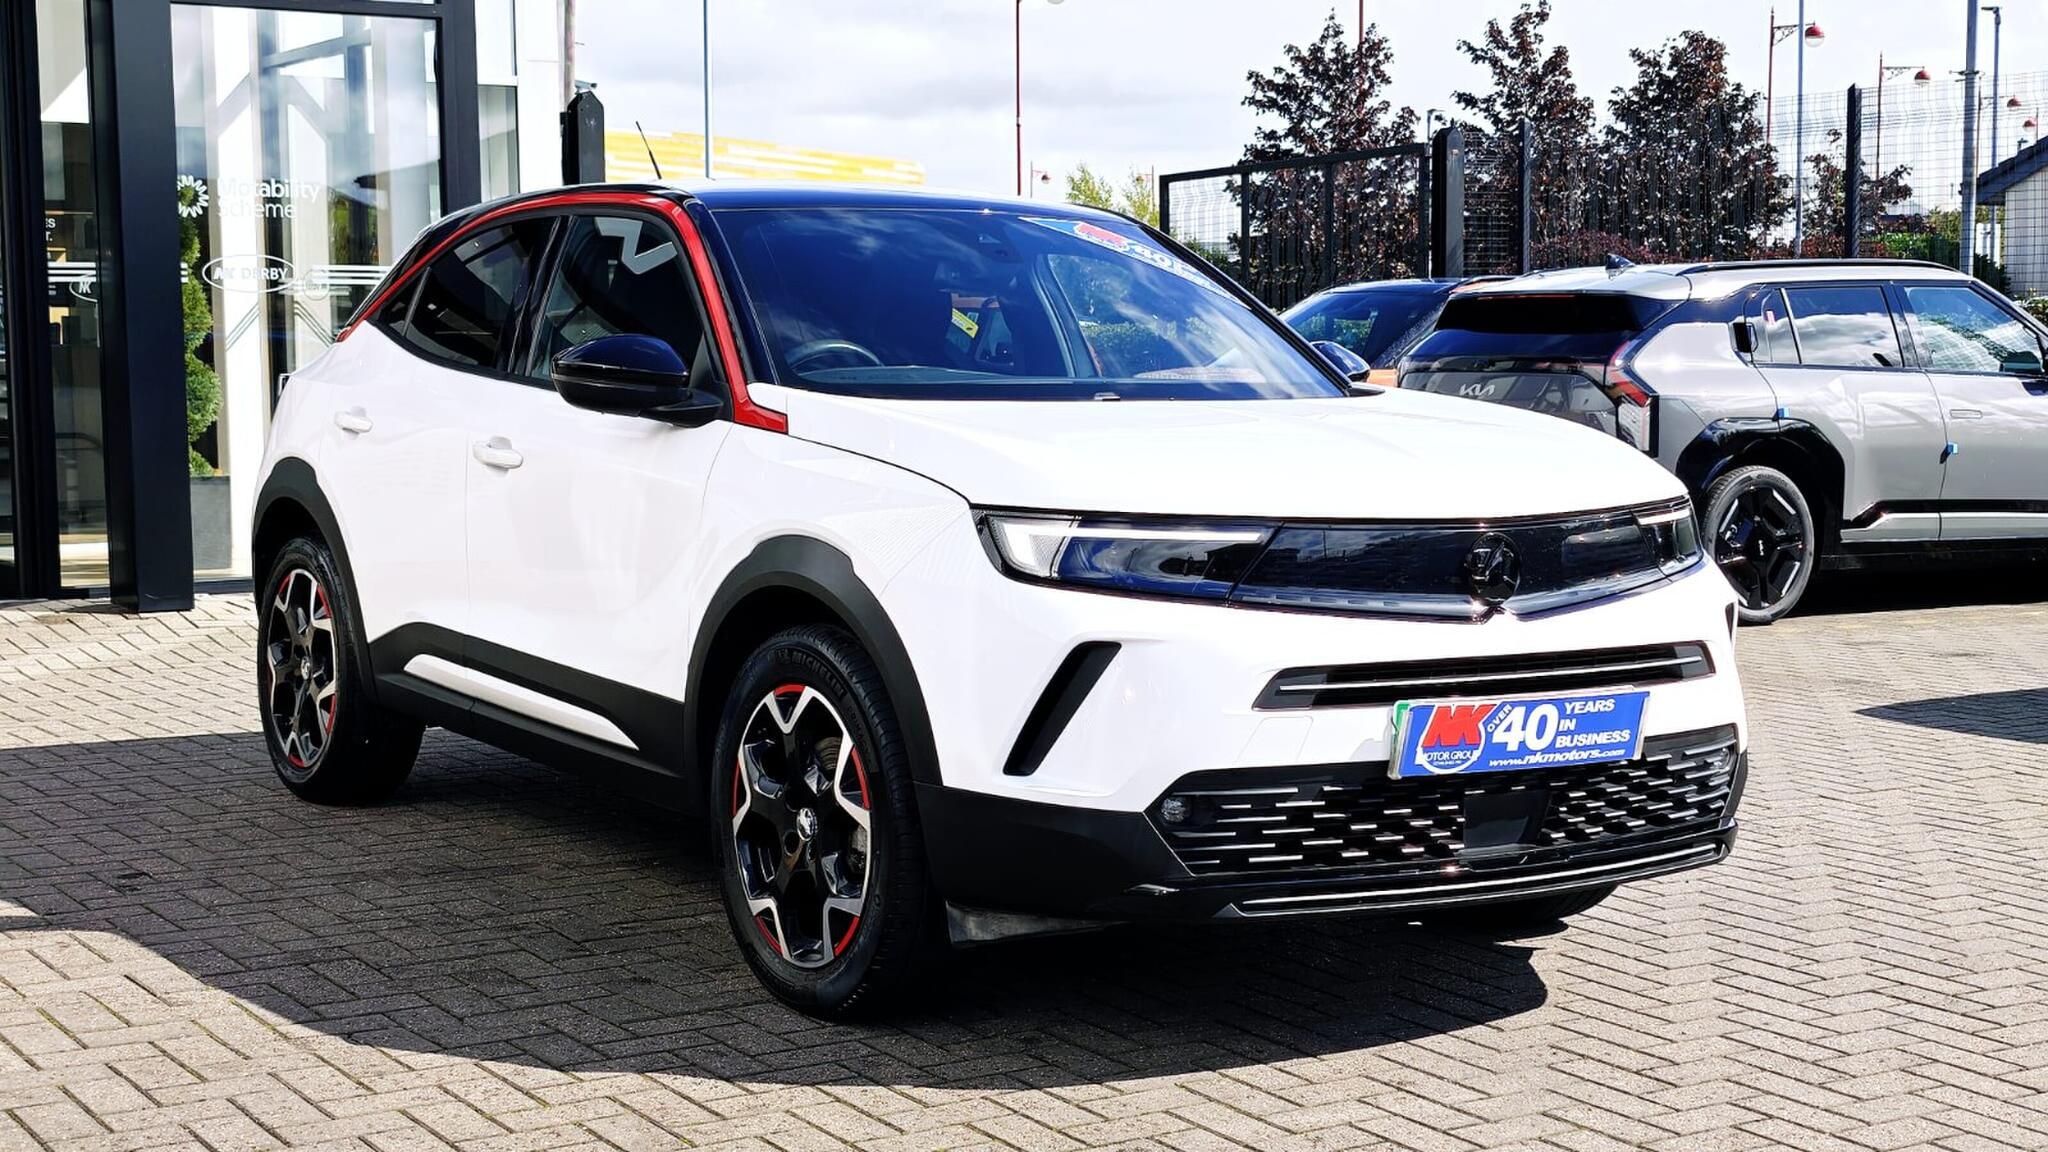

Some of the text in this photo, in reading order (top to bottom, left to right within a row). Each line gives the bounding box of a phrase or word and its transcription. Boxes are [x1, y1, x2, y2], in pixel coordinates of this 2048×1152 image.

[241, 267, 288, 280] DERBY
[1564, 699, 1616, 715] YEARS
[1421, 705, 1497, 748] NK
[1487, 704, 1559, 751] OVER 40
[1559, 719, 1577, 731] IN
[1555, 730, 1632, 748] BUSINESS
[1489, 749, 1625, 767] www.nkmotors.com
